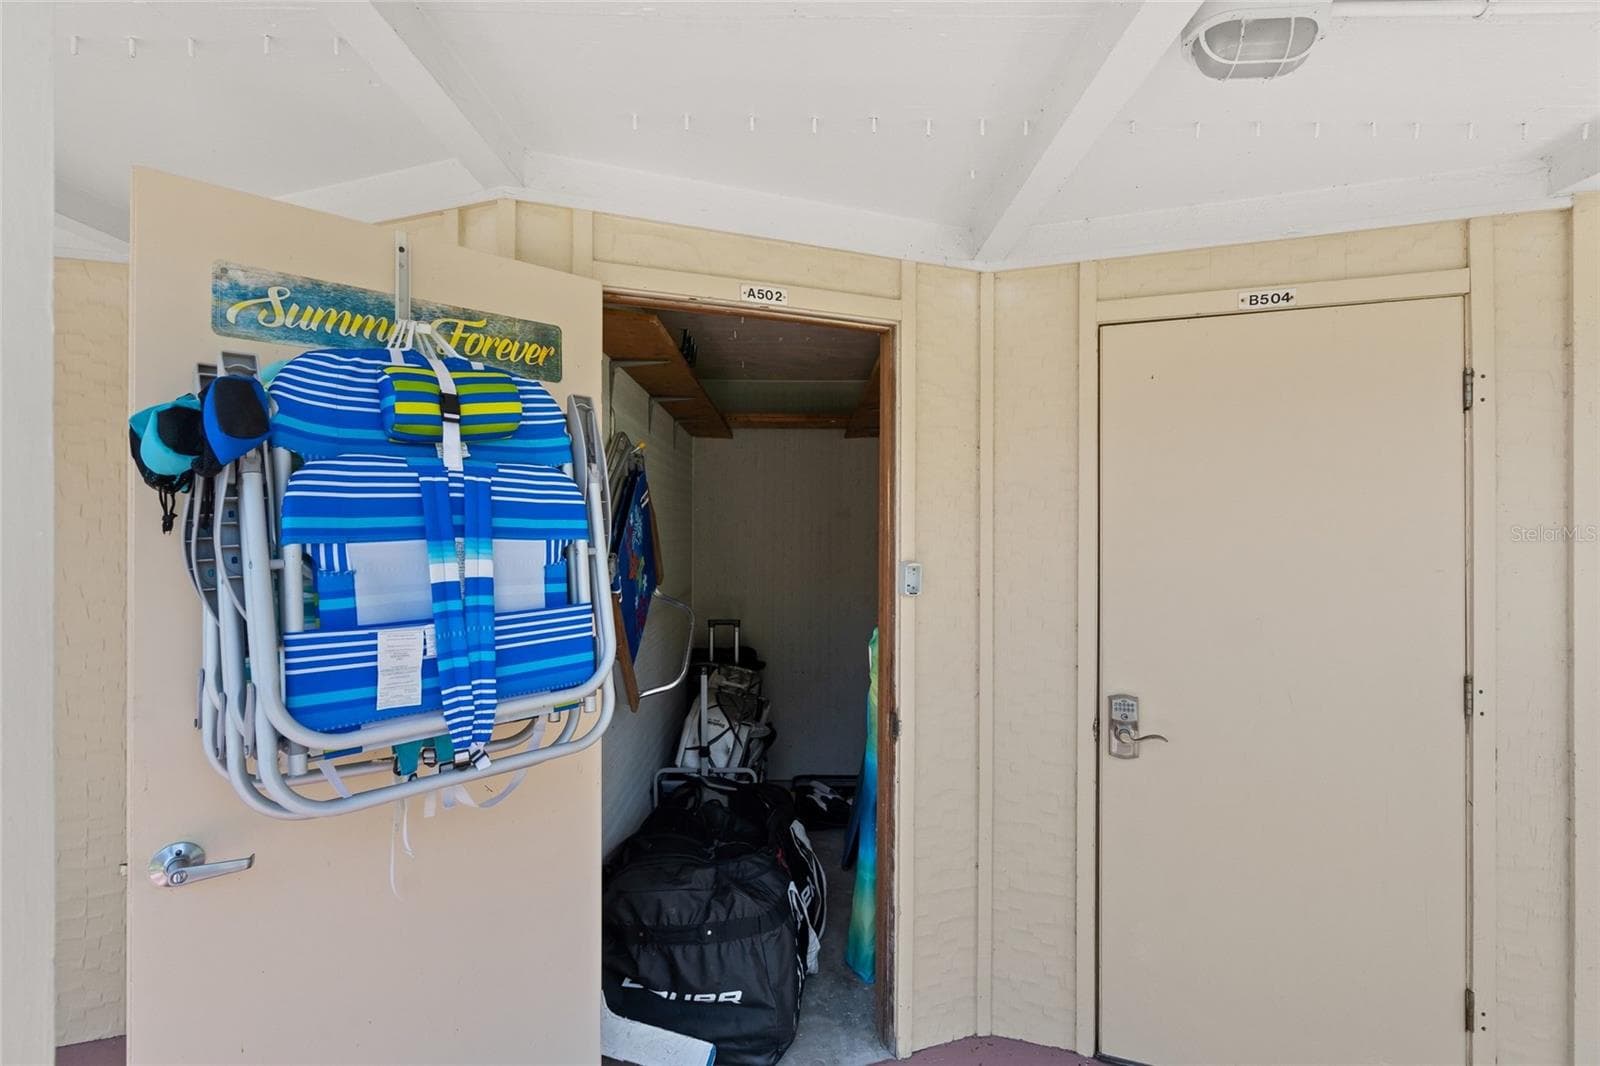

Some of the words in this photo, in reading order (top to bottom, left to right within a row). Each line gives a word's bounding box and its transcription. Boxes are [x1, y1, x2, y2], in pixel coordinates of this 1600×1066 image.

[747, 288, 782, 301] A502
[1249, 292, 1290, 305] B504
[431, 318, 556, 366] Forever
